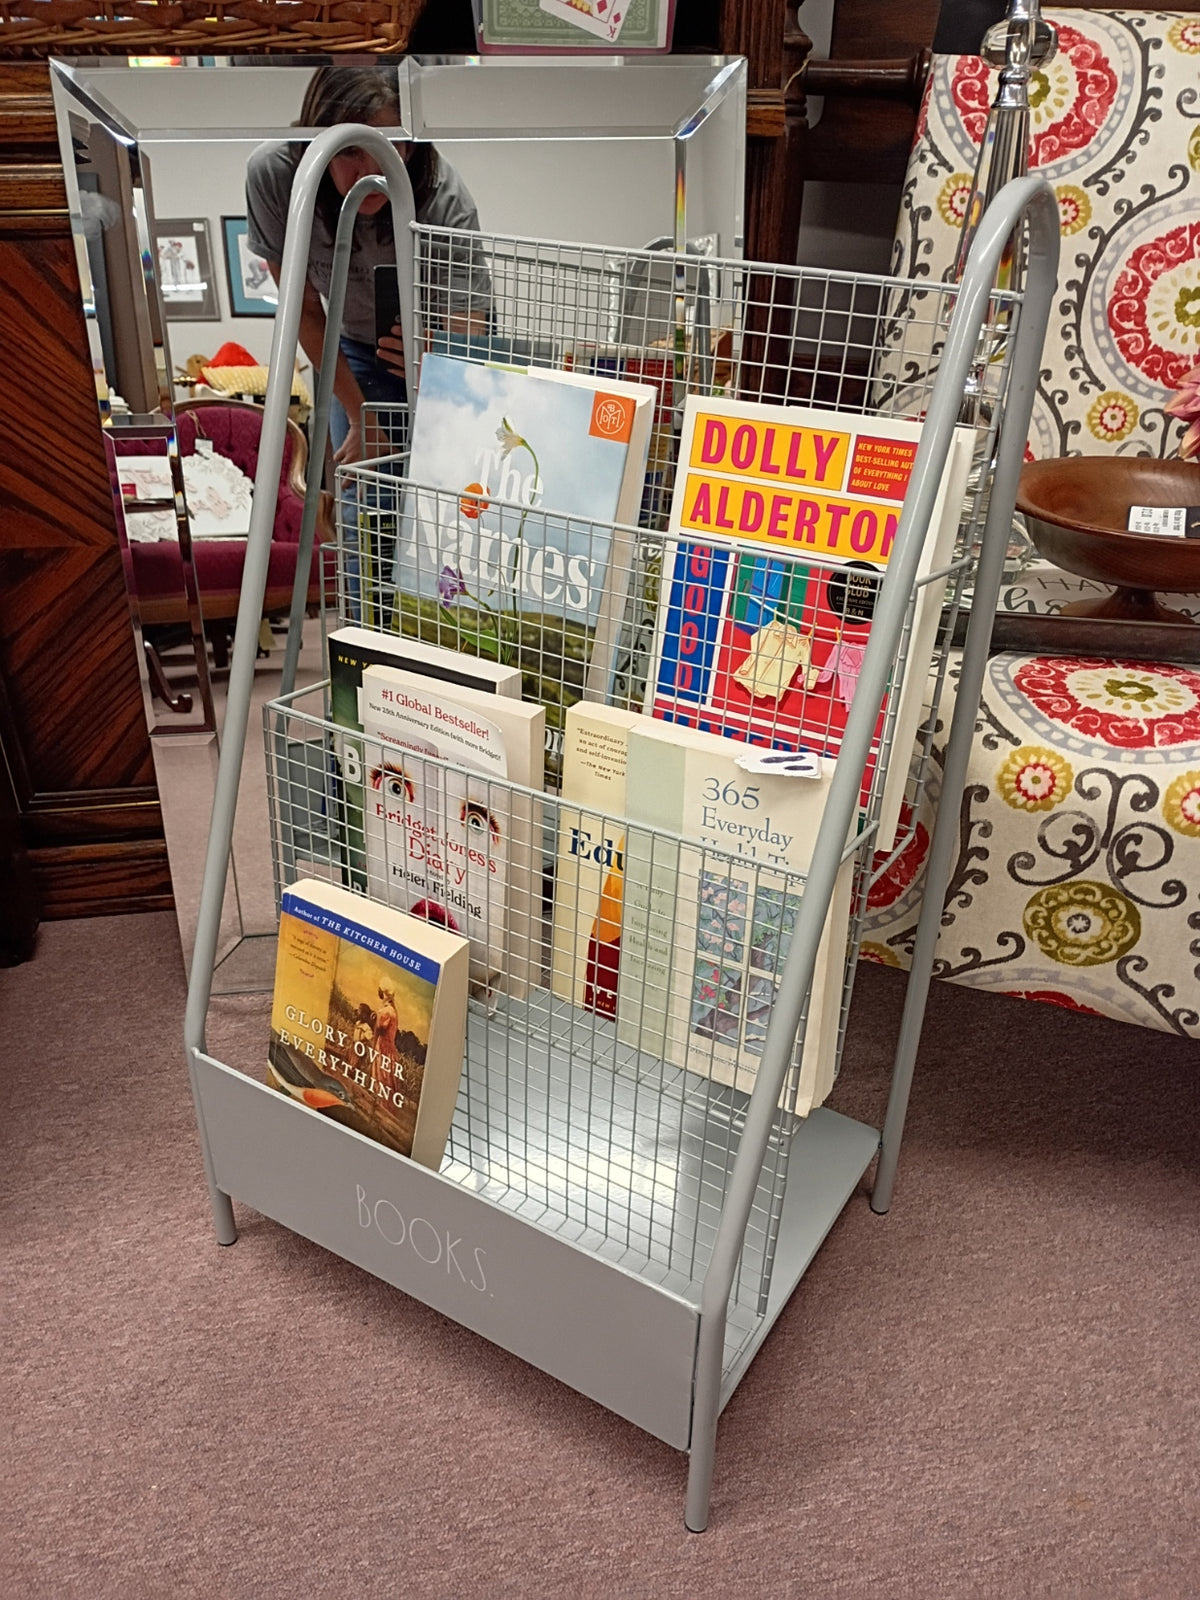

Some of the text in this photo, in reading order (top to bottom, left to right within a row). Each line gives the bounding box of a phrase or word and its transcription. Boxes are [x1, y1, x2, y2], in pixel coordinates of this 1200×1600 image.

[701, 420, 840, 481] DOLLY
[853, 466, 862, 475] OF
[863, 468, 903, 481] EVERYTHING
[855, 454, 899, 468] BEST-SELLING
[858, 443, 913, 457] NEW YORK TIMES
[475, 448, 544, 508] The
[851, 479, 890, 492] ABOUT LOVE
[406, 485, 596, 610] Names
[673, 545, 712, 692] GOOD
[338, 655, 357, 666] NEW
[369, 702, 382, 712] New
[396, 711, 429, 730] Anniversary
[430, 724, 450, 737] Edition
[465, 740, 478, 750] more
[382, 689, 489, 741] #1 Global Bestseller!
[594, 771, 611, 781] Times
[598, 764, 611, 772] New
[702, 777, 760, 810] 365
[701, 805, 794, 852] Everyday
[294, 906, 313, 919] Author
[321, 916, 341, 931] THE
[343, 928, 388, 953] KITCHEN
[389, 949, 422, 971] HOUSE
[285, 1005, 405, 1081] GLORY OVER
[280, 1028, 405, 1108] EVERYTHING
